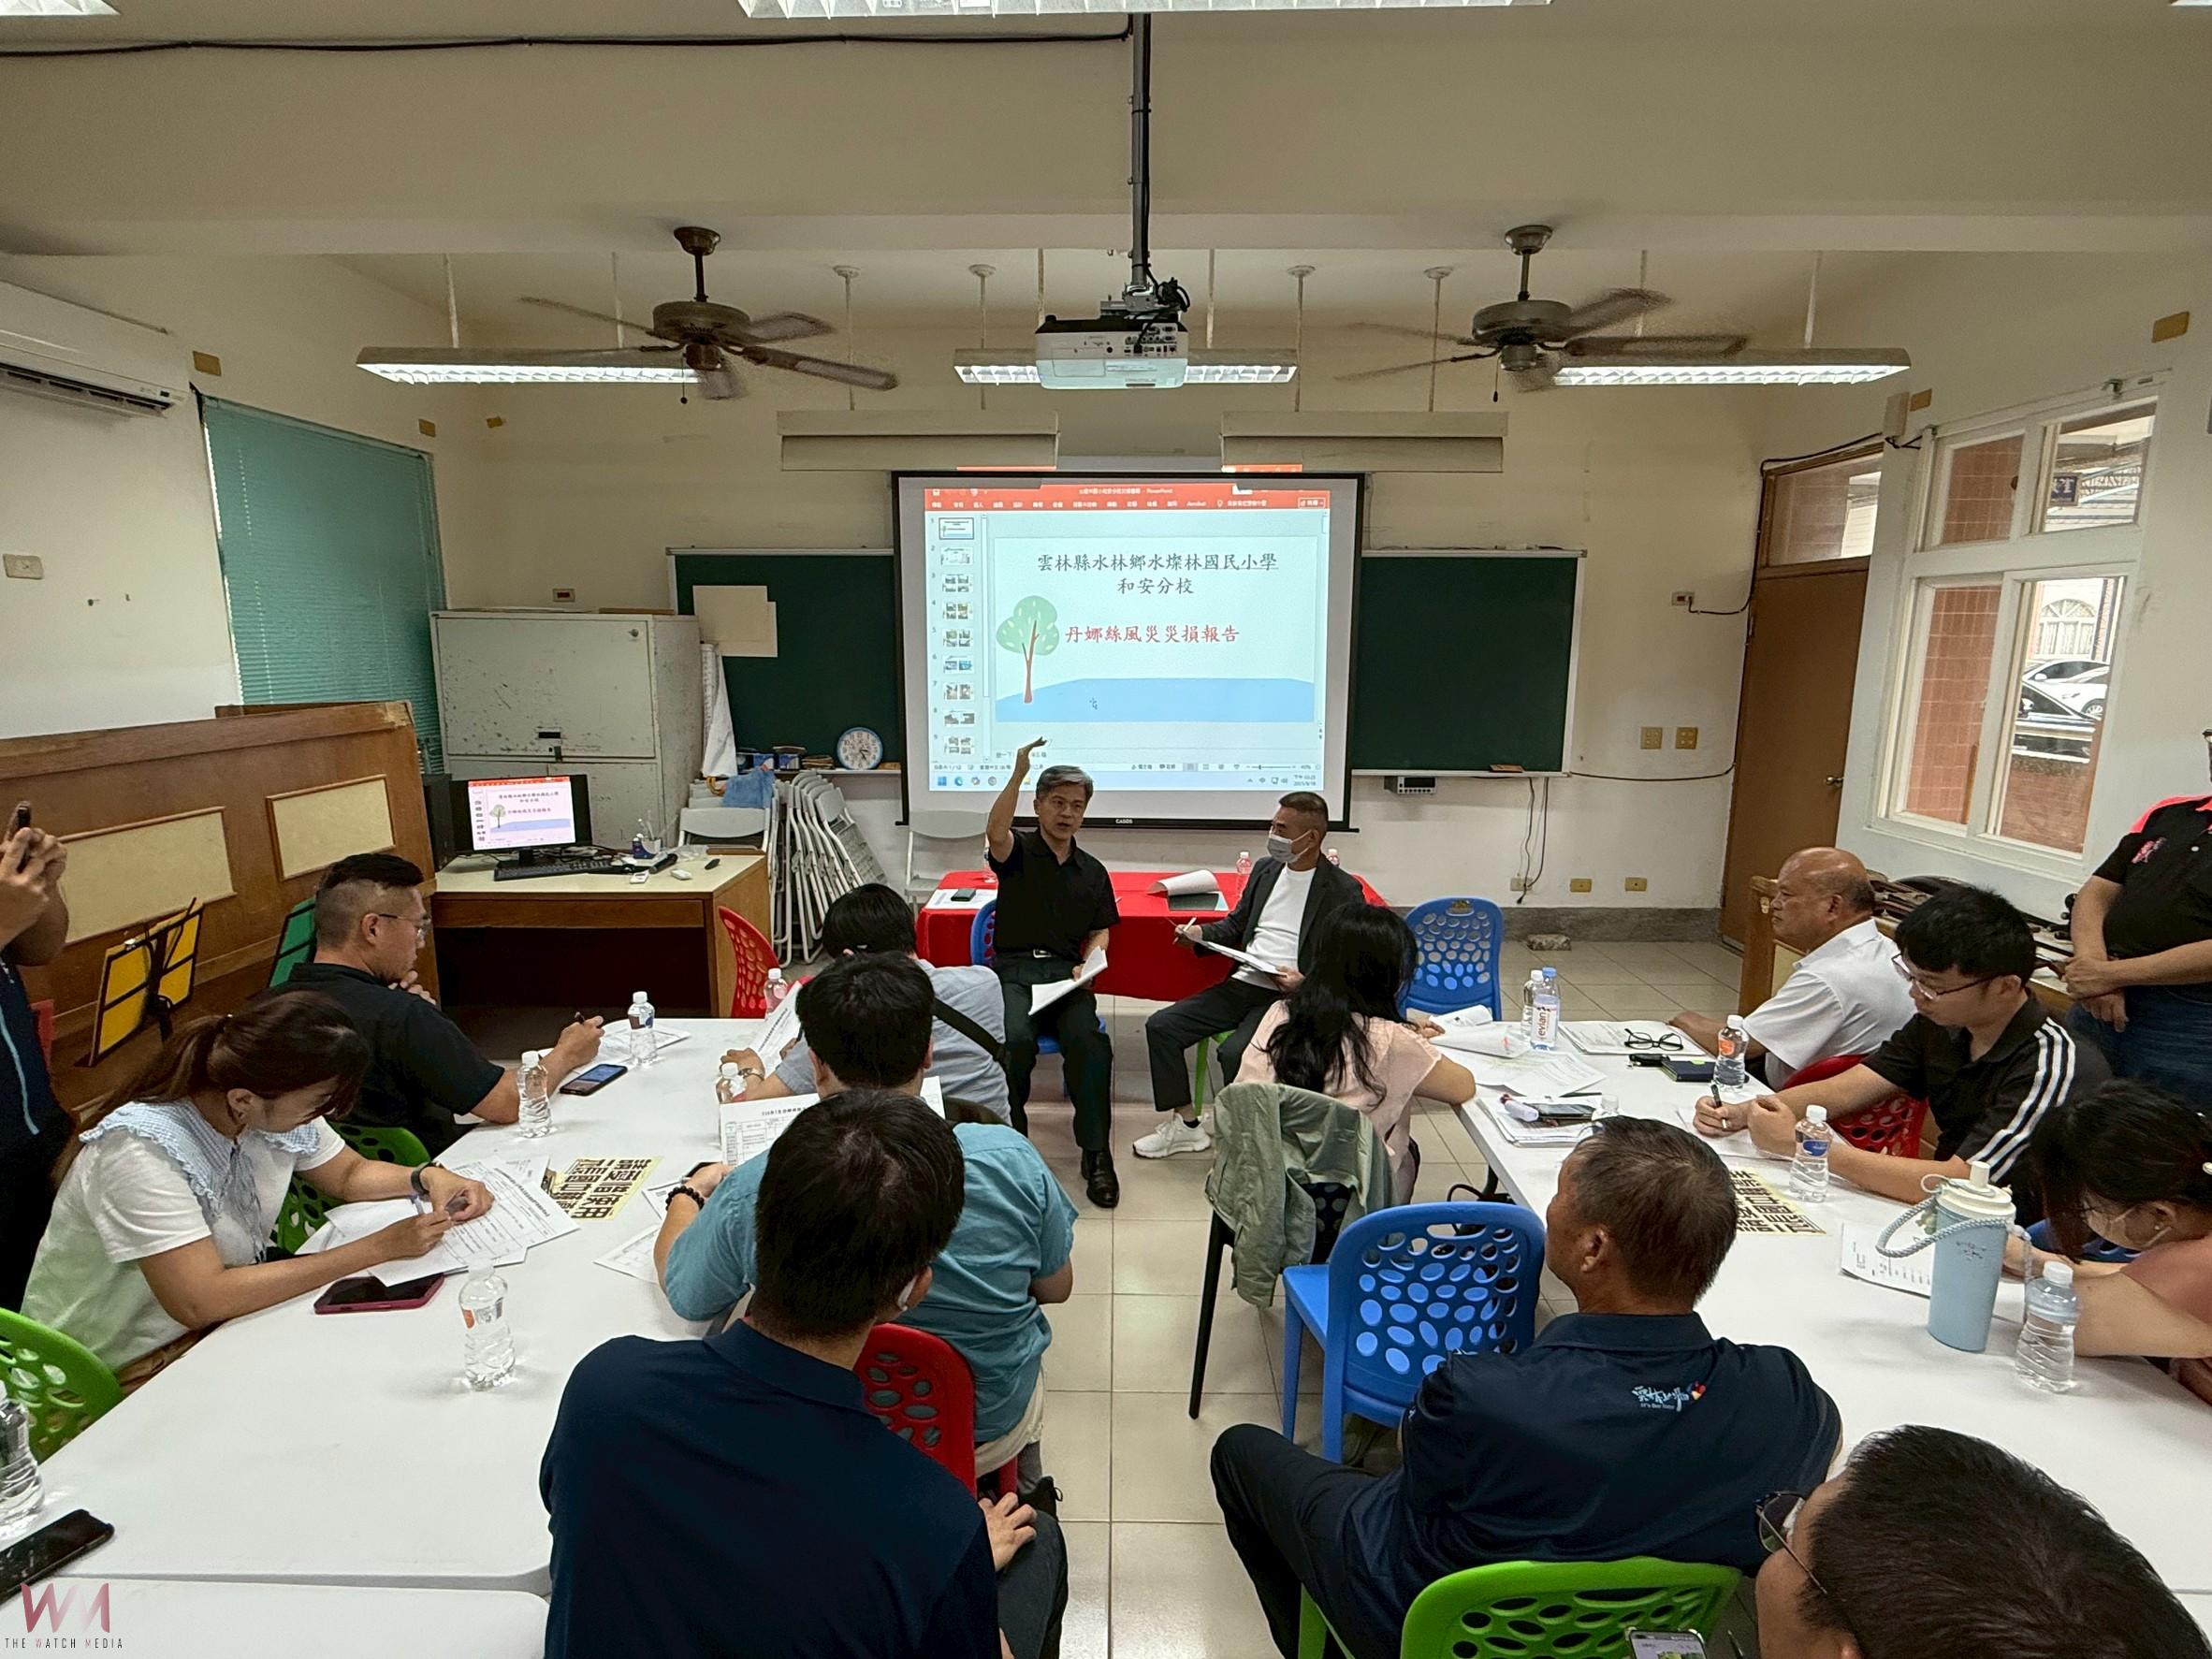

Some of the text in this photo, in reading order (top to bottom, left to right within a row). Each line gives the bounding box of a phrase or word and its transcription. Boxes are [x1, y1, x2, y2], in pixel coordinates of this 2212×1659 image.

[1038, 553, 1277, 572] 雲林縣水林鄉水燦林國民小學
[1117, 577, 1194, 594] 和安分校
[1065, 624, 1240, 644] 丹娜絲風災災損報告
[1537, 1011, 1547, 1037] evian
